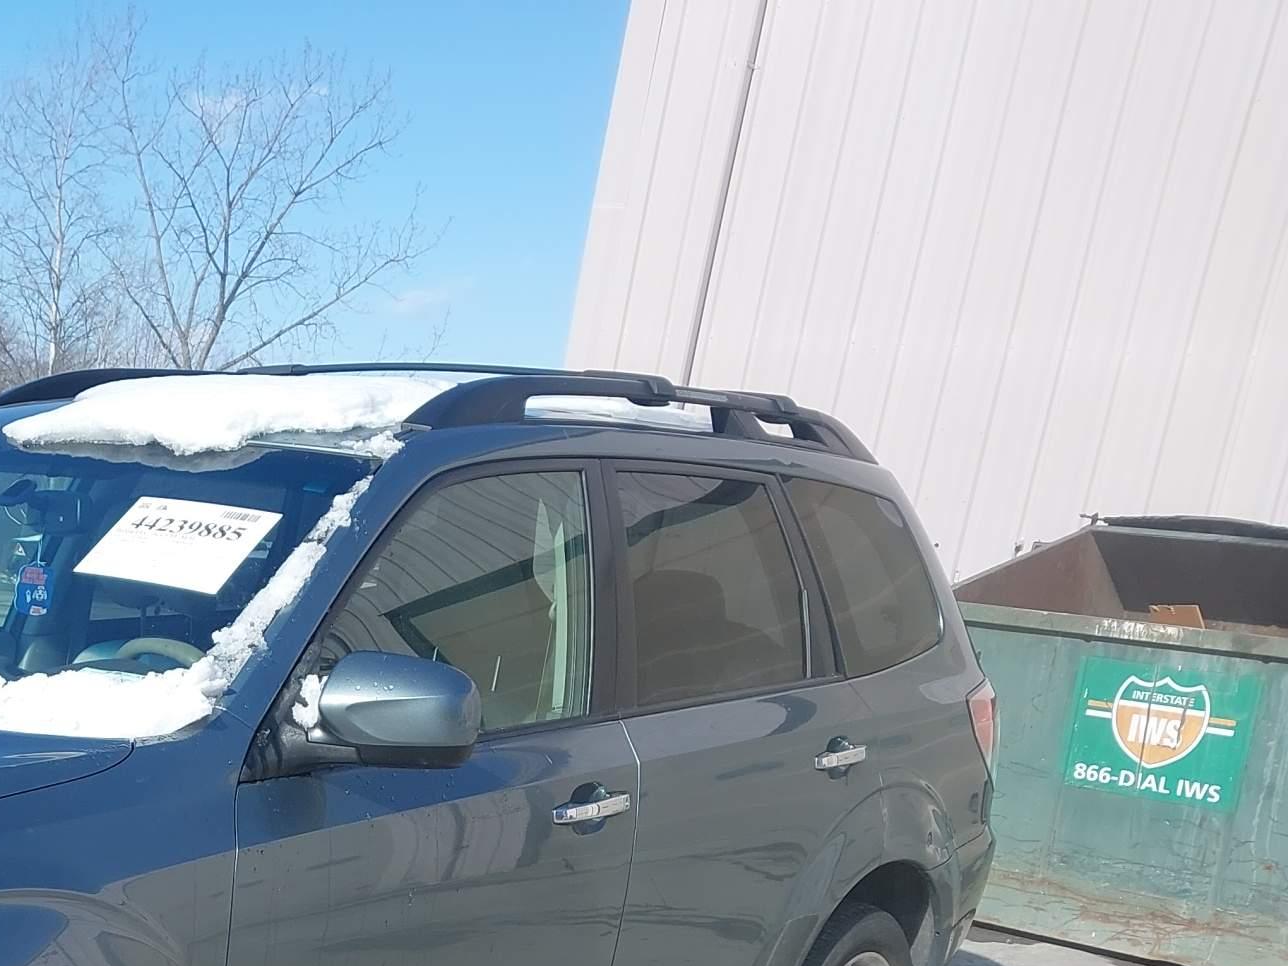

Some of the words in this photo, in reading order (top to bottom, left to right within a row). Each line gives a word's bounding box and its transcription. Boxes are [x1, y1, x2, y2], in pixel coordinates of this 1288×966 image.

[131, 515, 248, 541] 44239885
[1132, 690, 1196, 707] INTERSTATE
[1127, 713, 1184, 750] IWS
[1073, 763, 1170, 795] 866-DIAL
[1176, 780, 1221, 803] IWS
